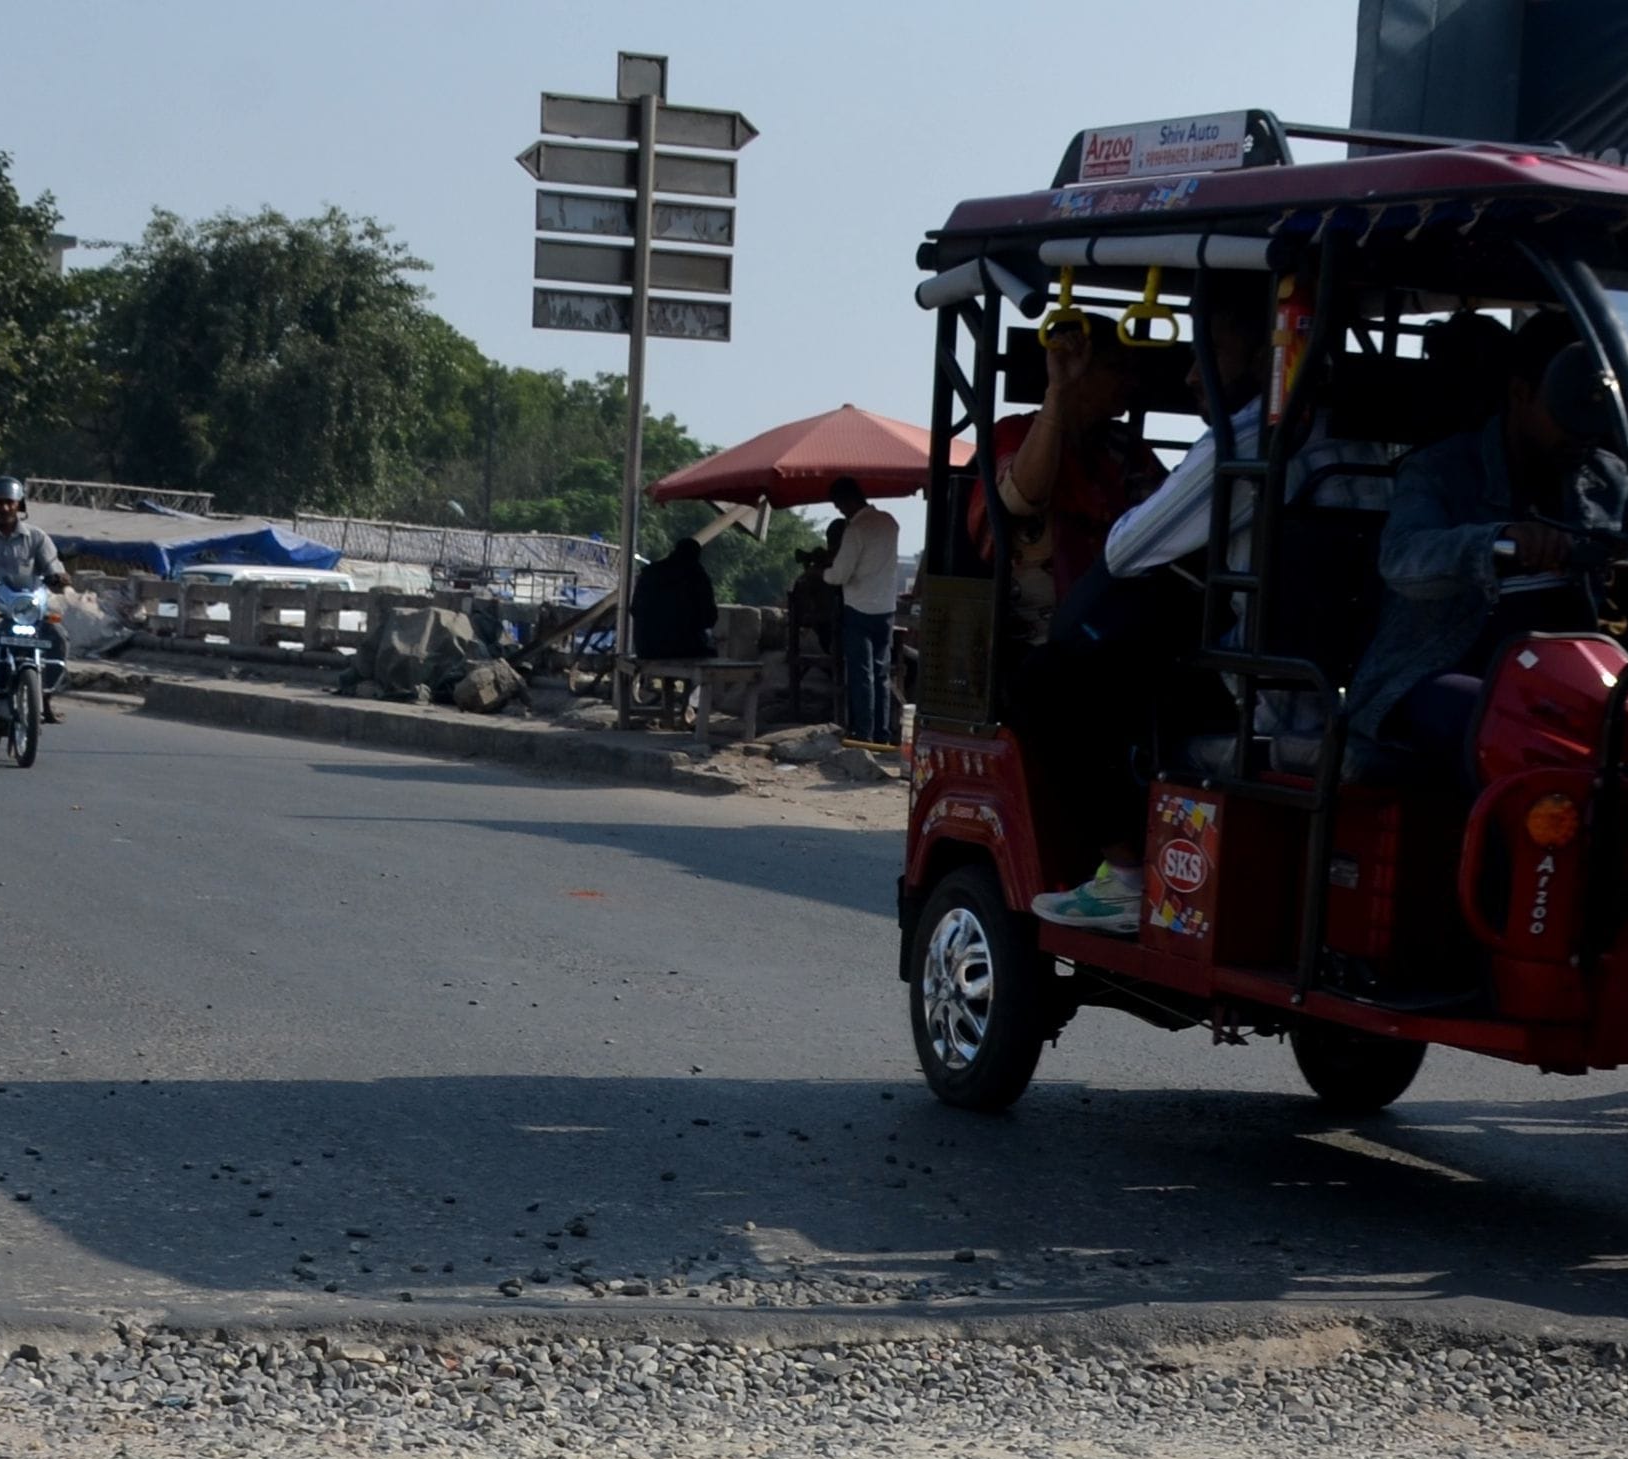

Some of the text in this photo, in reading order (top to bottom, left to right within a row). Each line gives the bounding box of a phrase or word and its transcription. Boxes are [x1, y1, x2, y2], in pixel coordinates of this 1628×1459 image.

[1085, 134, 1132, 161] Arzoo
[1159, 122, 1219, 146] Shiv Auto
[1165, 848, 1202, 883] SKS
[1530, 855, 1555, 935] Arzoo
